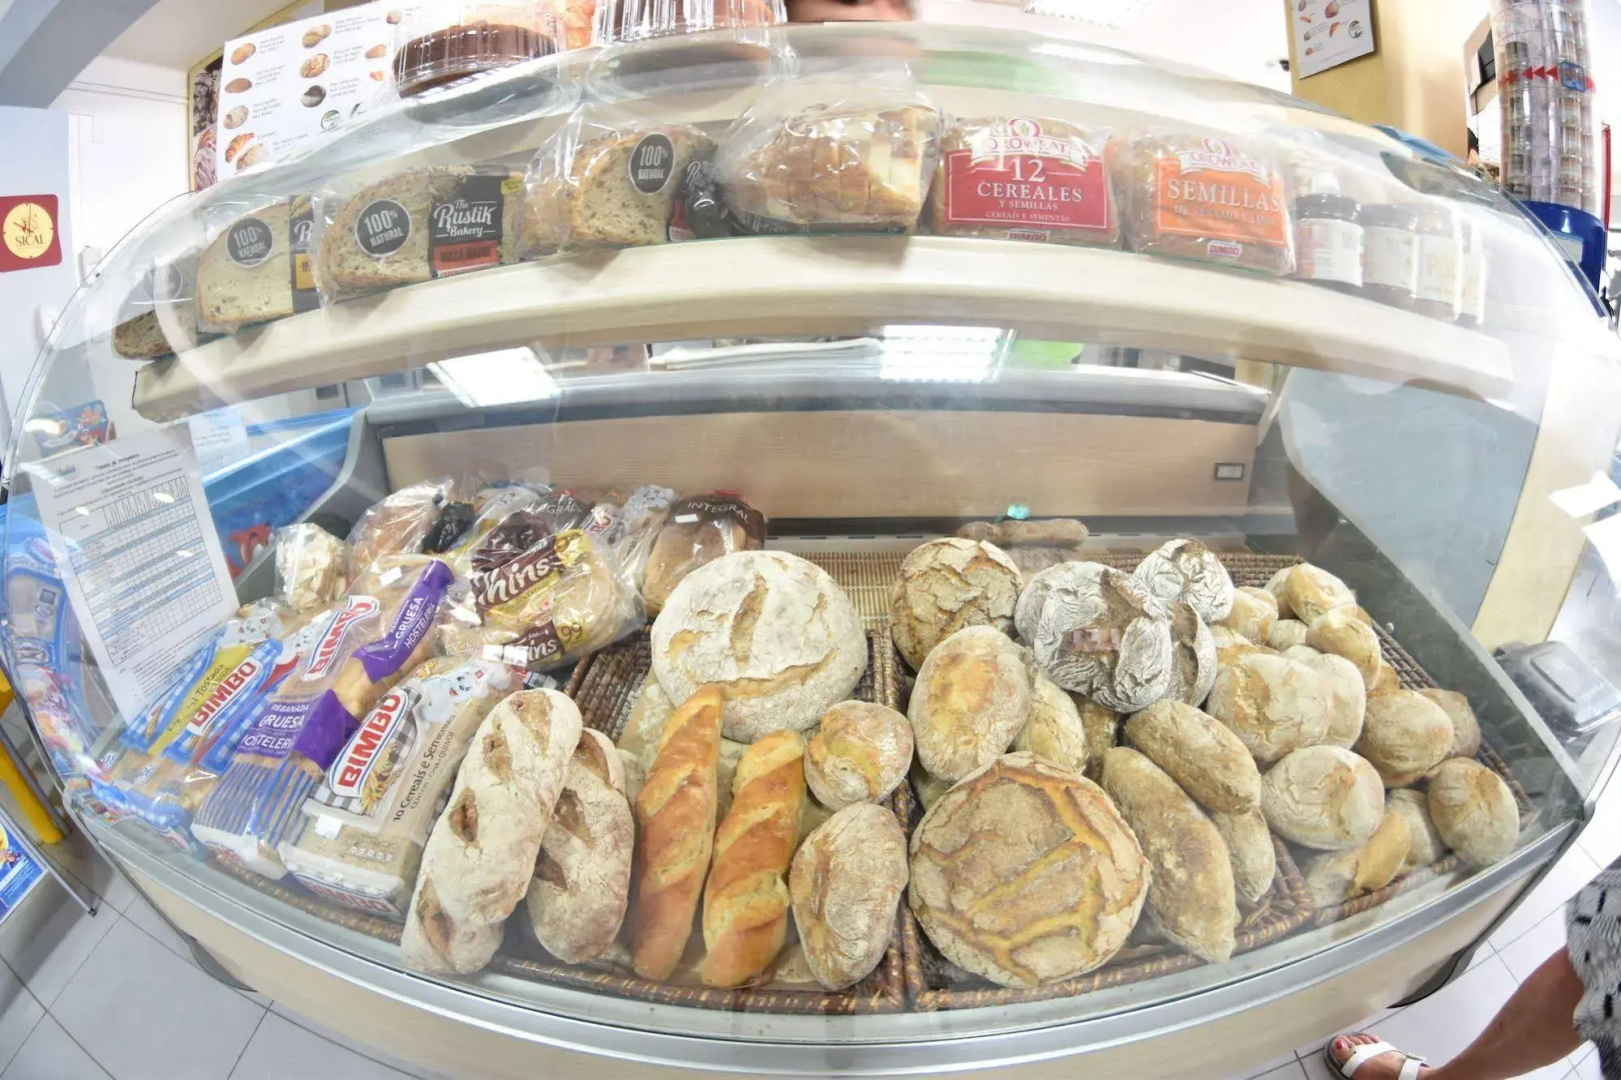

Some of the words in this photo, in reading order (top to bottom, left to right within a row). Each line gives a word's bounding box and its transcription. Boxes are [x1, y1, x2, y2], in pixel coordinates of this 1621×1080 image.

[637, 169, 665, 180] NATURAL
[1012, 158, 1047, 183] 12
[455, 199, 469, 209] The
[977, 182, 1083, 203] CEREALES
[1167, 178, 1282, 213] SEMILLAS
[999, 200, 1006, 208] Y
[1008, 200, 1059, 211] SEMILLAS
[364, 208, 399, 236] 100%
[433, 203, 497, 232] Rustik
[15, 234, 45, 247] SICAL
[233, 224, 263, 249] 100%
[369, 226, 404, 249] NATURAL
[449, 225, 484, 238] Bakery
[237, 242, 268, 258] NATURAL
[687, 501, 749, 525] INTEGRAL
[395, 596, 424, 640] GRUESA
[560, 621, 583, 645] 99
[528, 639, 558, 661] ins
[190, 661, 257, 728] BIMBO
[270, 703, 310, 713] REBANADA
[259, 713, 306, 729] GRUESA
[337, 694, 401, 788] BIMBO
[393, 810, 405, 822] 10
[401, 769, 427, 810] Cereais
[424, 714, 456, 761] Sementes
